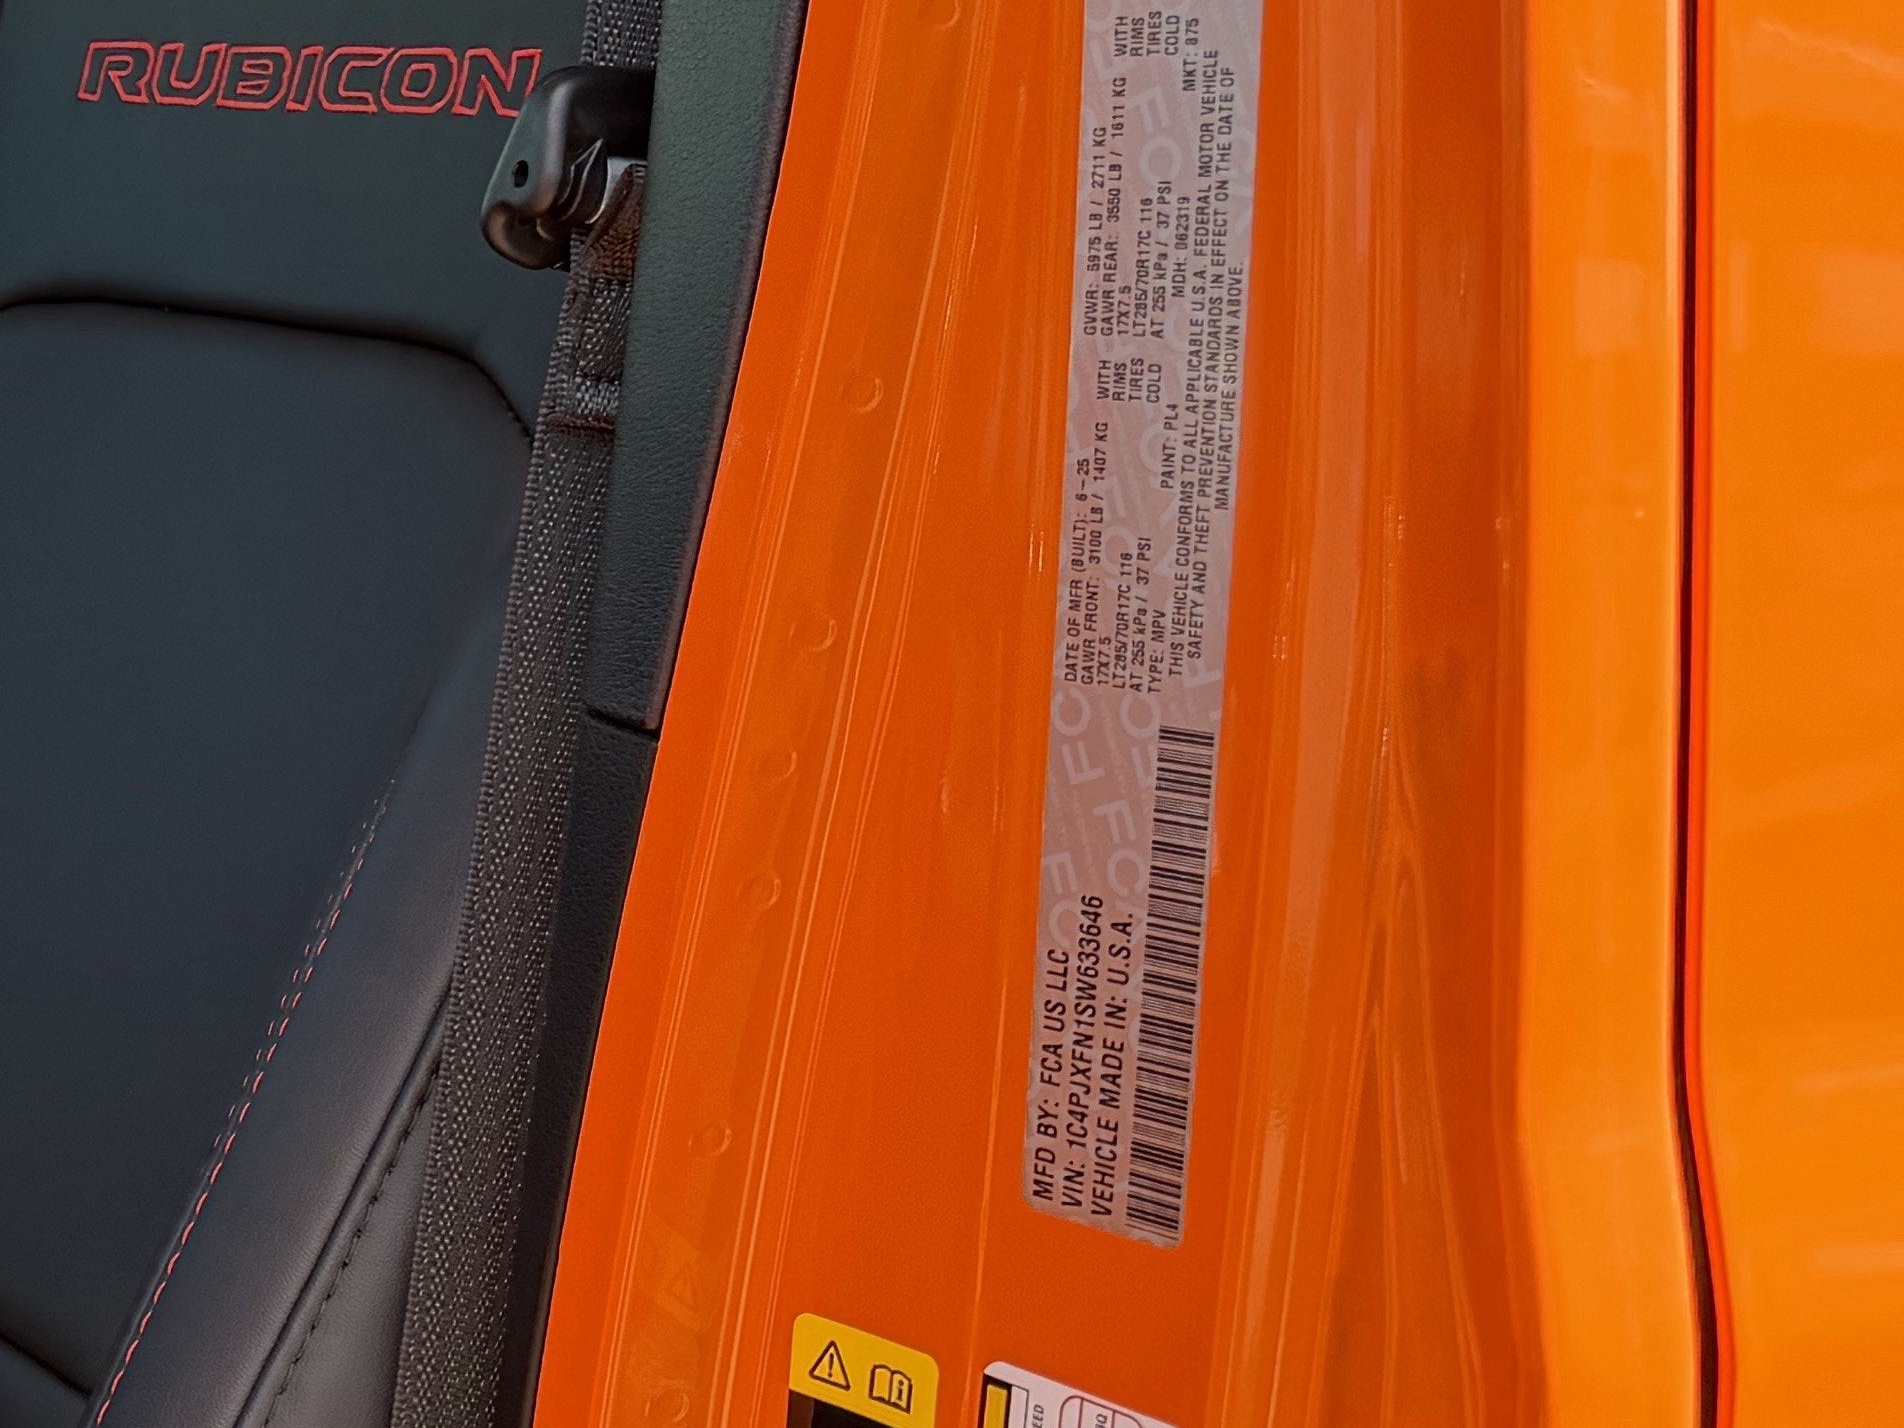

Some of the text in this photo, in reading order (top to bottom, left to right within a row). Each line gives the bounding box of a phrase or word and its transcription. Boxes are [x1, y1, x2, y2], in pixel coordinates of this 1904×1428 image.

[1113, 15, 1128, 57] WITH
[1129, 16, 1145, 57] RIMS
[1145, 10, 1162, 57] TIRES
[1163, 14, 1180, 56] COLD
[1181, 17, 1199, 91] MKT: 875
[77, 40, 542, 119] RUBICON
[1082, 126, 1107, 336] GVWR: 5975 LB 2711 KG
[1099, 76, 1127, 336] GAWR REAR: 3550 LB 1611 KG
[1139, 197, 1153, 222] 116
[1170, 195, 1190, 298] MDH: 062319
[1149, 180, 1172, 339] AT 255 kPa 37 PSI
[1115, 284, 1132, 335] 17X7.5
[1095, 359, 1111, 400] WITH
[1111, 361, 1127, 401] RIMS
[1127, 357, 1144, 402] TIRES
[1145, 362, 1162, 403] COLD
[1167, 49, 1219, 677] THIS VEHICLE CONFORMS TO ALL APPLICABLE U.S.A. FEDERAL MOTOR VEHICLE
[1186, 66, 1234, 659] SAFETY AND THEFT PREVENTION STANDARDS IN EFFECT ON THE DATE OF
[1213, 262, 1243, 510] MANUFACTURE SHOWN ABOVE.
[1159, 403, 1179, 489] PAINT: PL4
[1080, 421, 1108, 685] GAWR FRONT: 3100 LB 1407 KG
[1118, 551, 1133, 577] 116
[1063, 512, 1089, 682] DATE OF MFR (BUILT):
[1128, 536, 1151, 692] AT 255 kPa 37 PSI
[1096, 635, 1112, 685] 17X7.5
[1146, 608, 1166, 694] TYPE: MPV
[1031, 948, 1069, 1201] MFD BY: FCA US LLC
[1060, 894, 1104, 1207] VIN: 1C4PJXFN1SW633646
[1090, 912, 1133, 1216] VEHICLE MADE IN: U.S.A.
